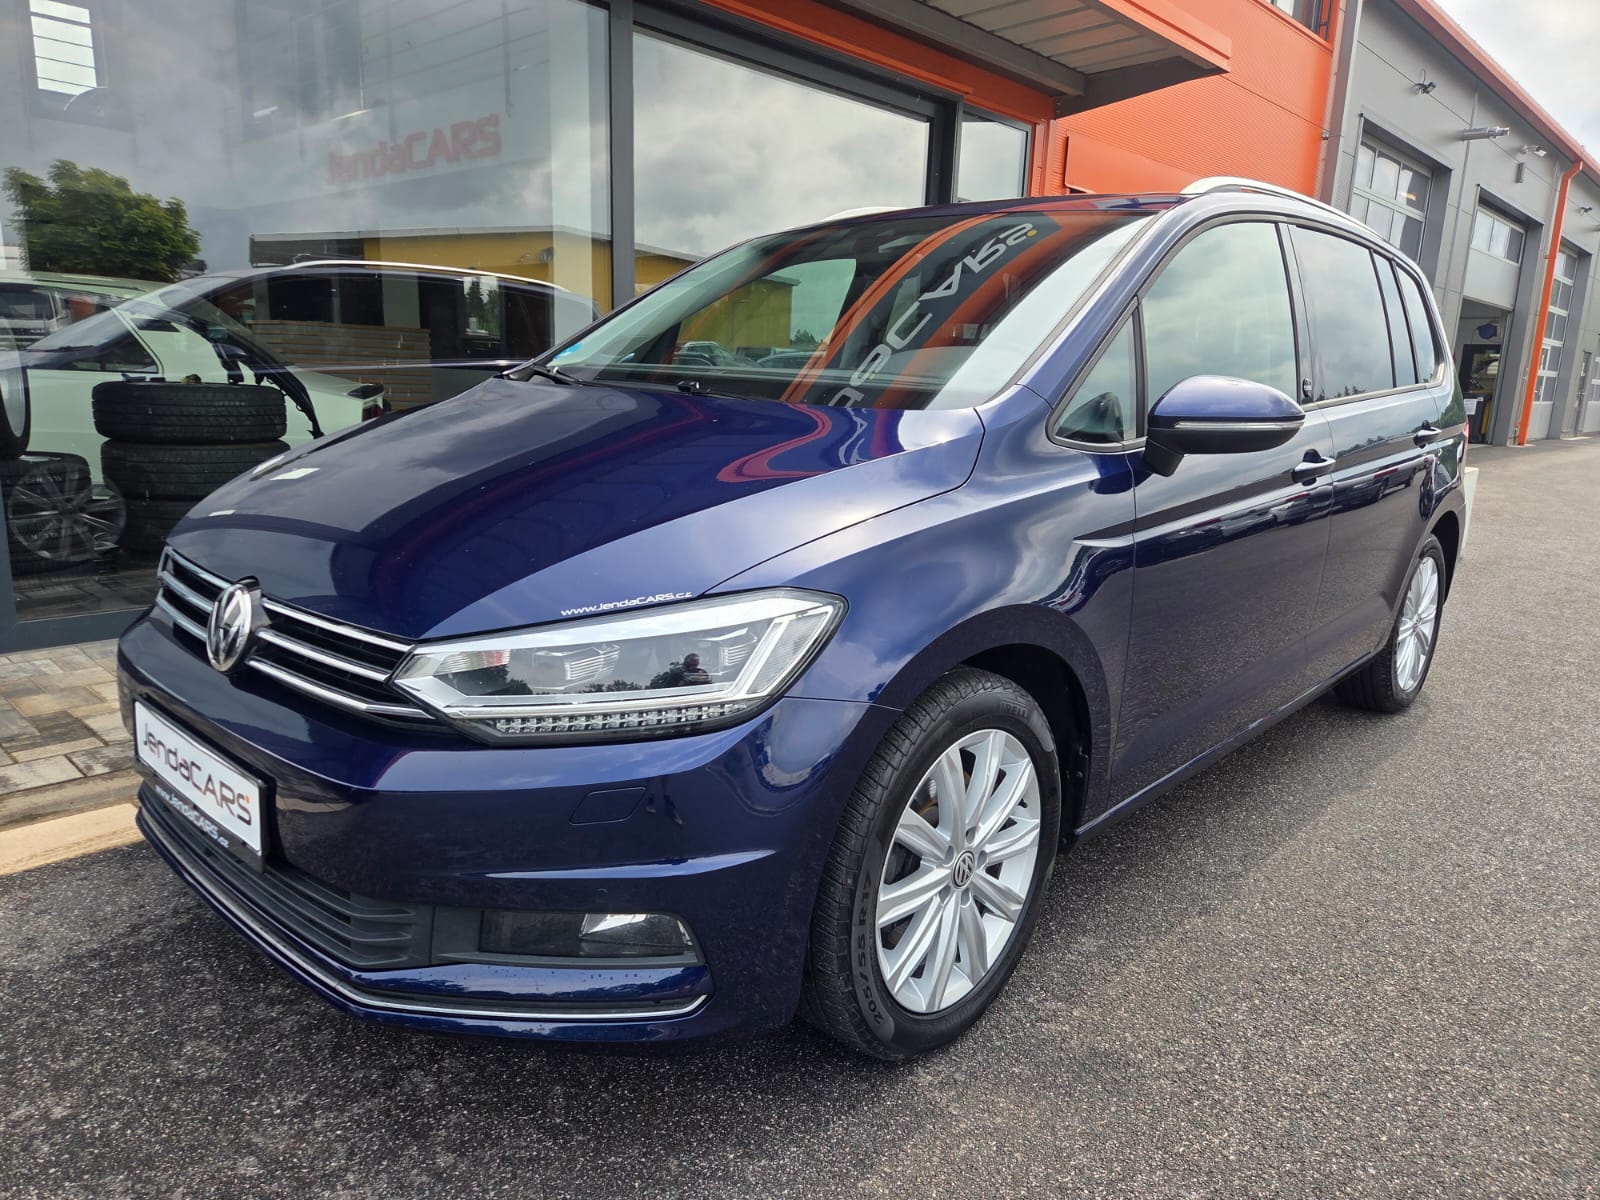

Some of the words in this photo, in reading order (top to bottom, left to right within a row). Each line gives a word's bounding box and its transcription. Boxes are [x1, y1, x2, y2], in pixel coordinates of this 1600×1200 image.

[560, 591, 693, 617] www.JendaCARS.cz
[143, 722, 253, 826] JendaCARS
[857, 933, 885, 1025] 205/55
